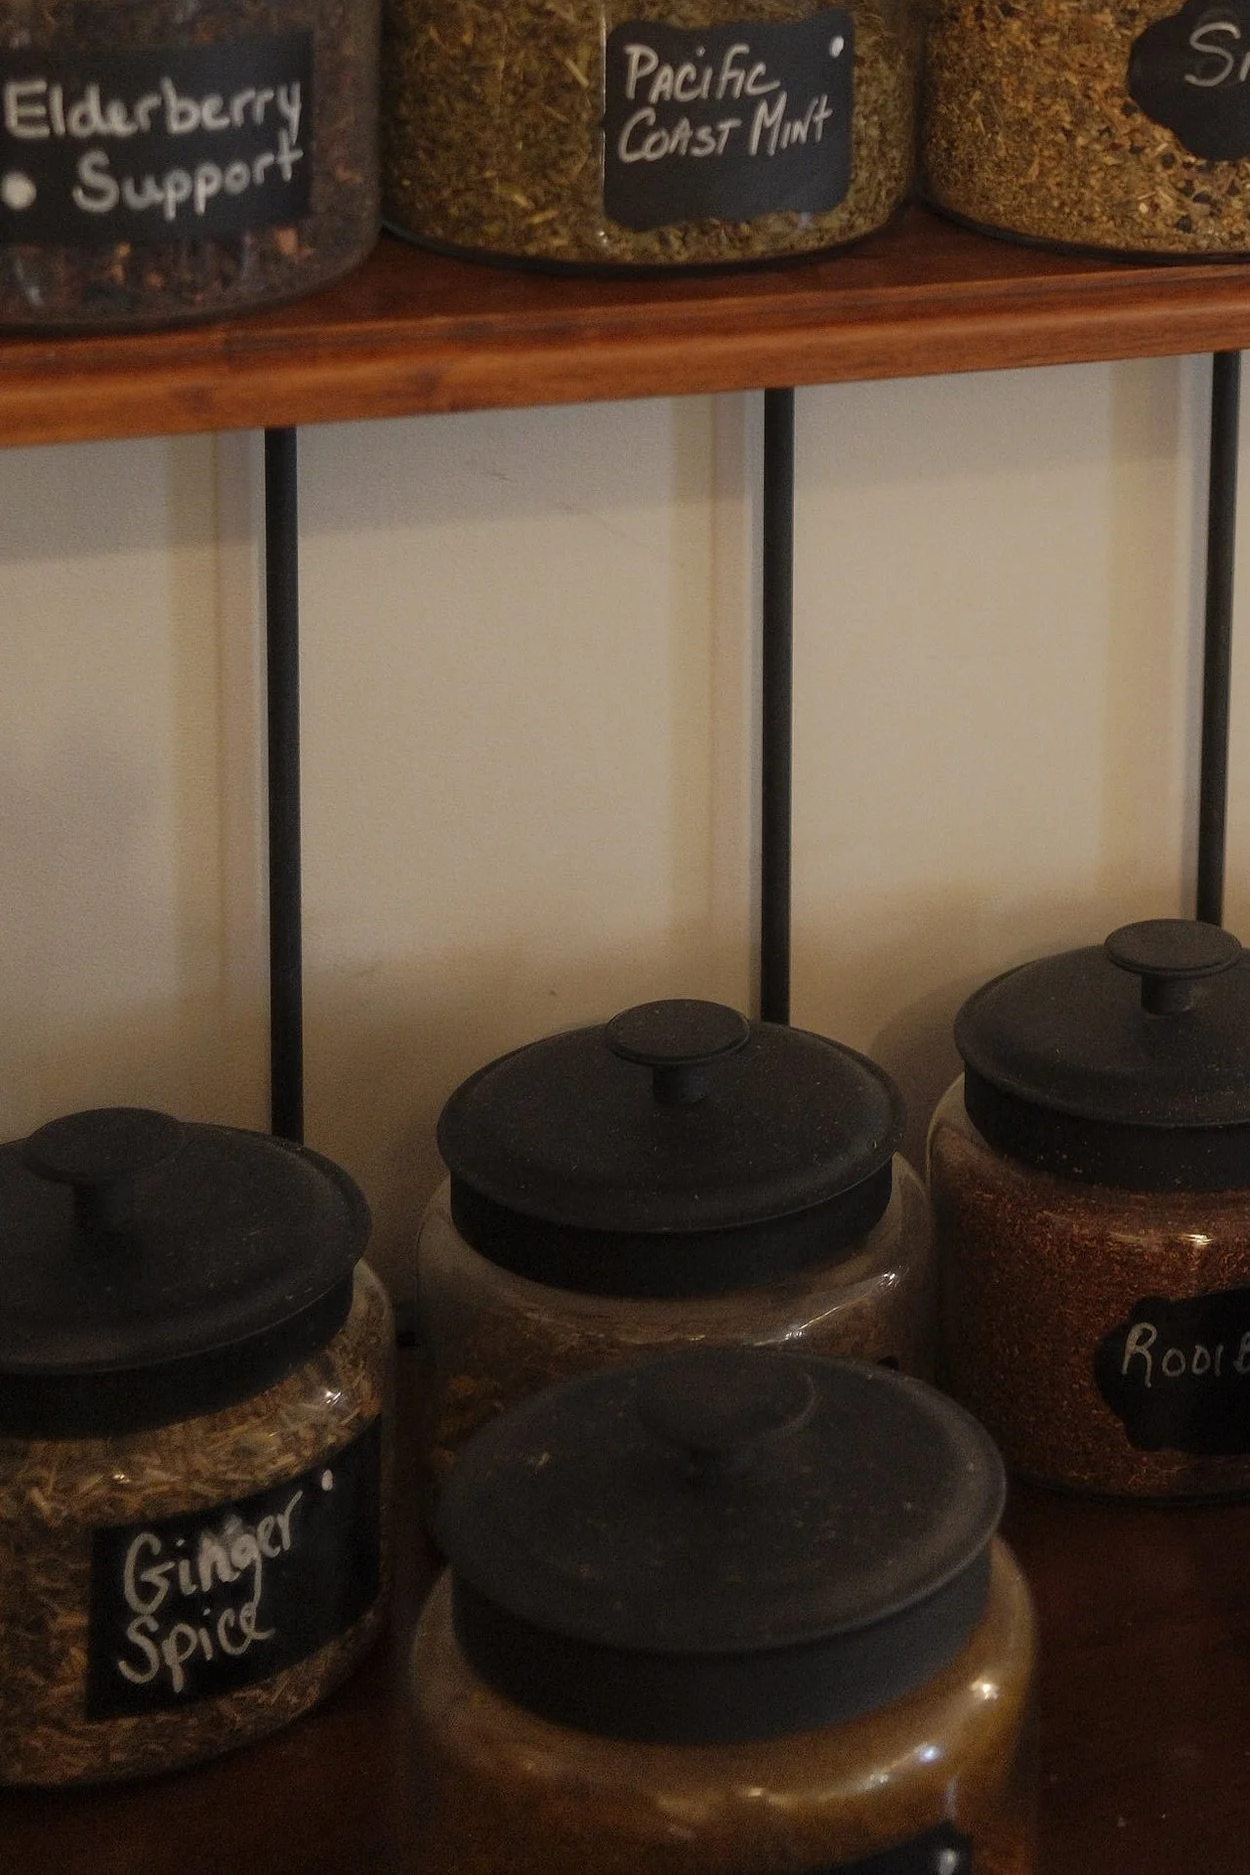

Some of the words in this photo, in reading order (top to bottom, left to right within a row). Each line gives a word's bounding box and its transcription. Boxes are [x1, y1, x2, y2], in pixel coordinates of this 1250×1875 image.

[4, 76, 302, 145] Elderberry
[71, 128, 305, 222] Support
[122, 1489, 304, 1617] Ginger
[116, 1601, 277, 1694] Spice
